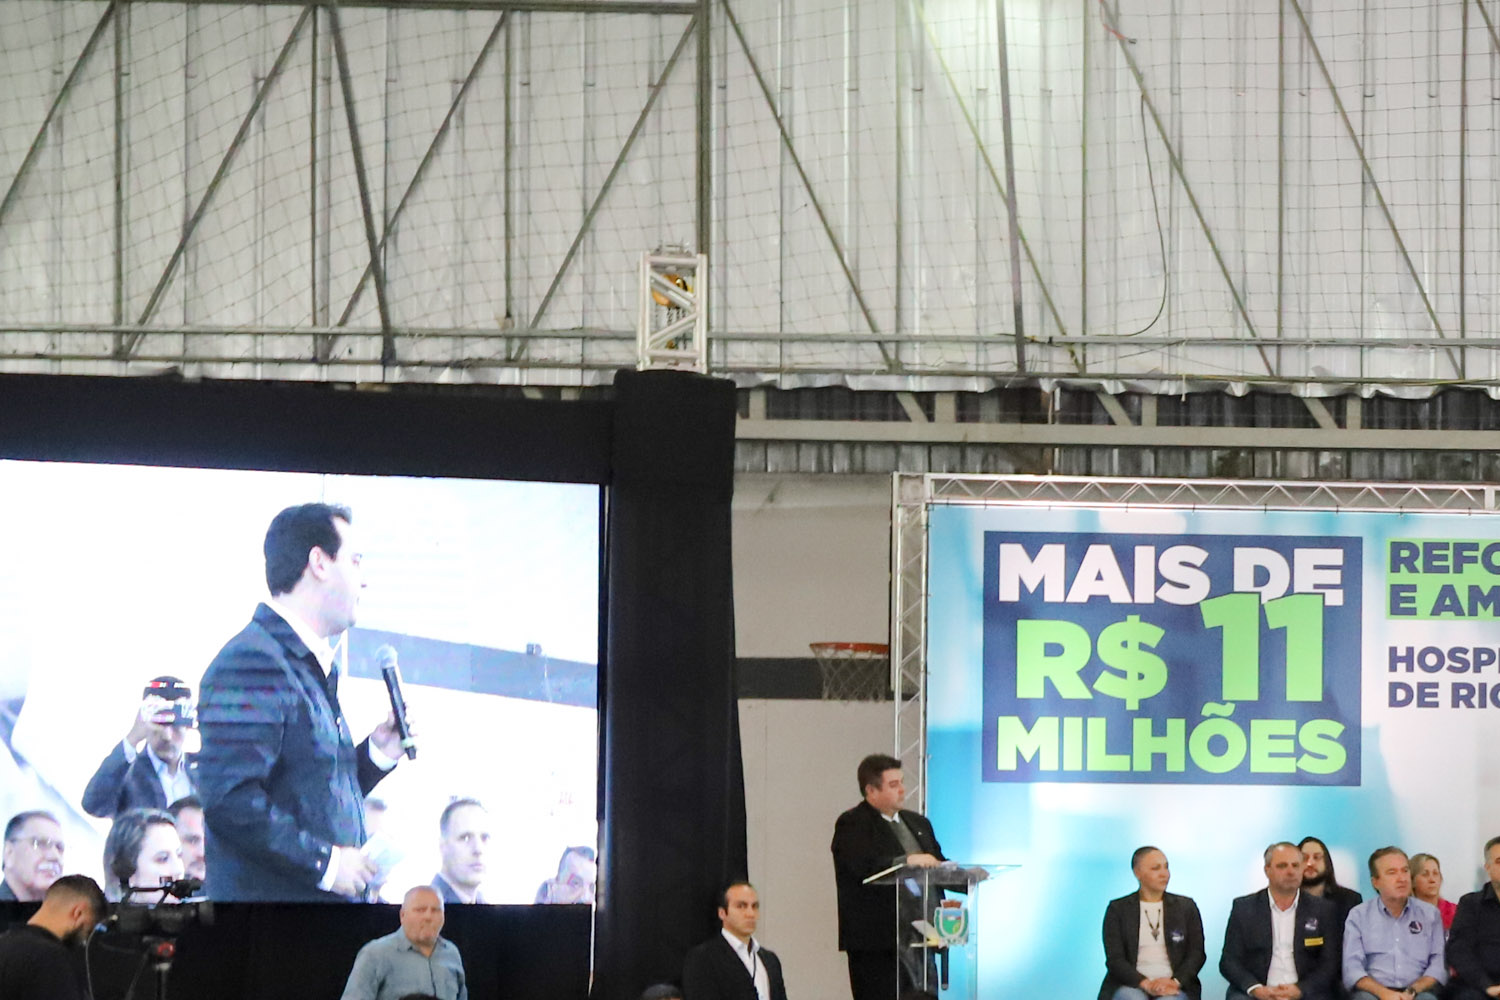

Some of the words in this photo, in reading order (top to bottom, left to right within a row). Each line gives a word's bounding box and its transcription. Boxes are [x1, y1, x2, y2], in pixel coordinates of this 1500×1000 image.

[998, 543, 1211, 605] MAIS
[1233, 547, 1345, 607] DE
[1389, 584, 1417, 616] E
[1015, 615, 1168, 711] R$
[1200, 592, 1324, 702] 11
[1387, 682, 1440, 709] DE
[997, 702, 1347, 775] MILHÕES
